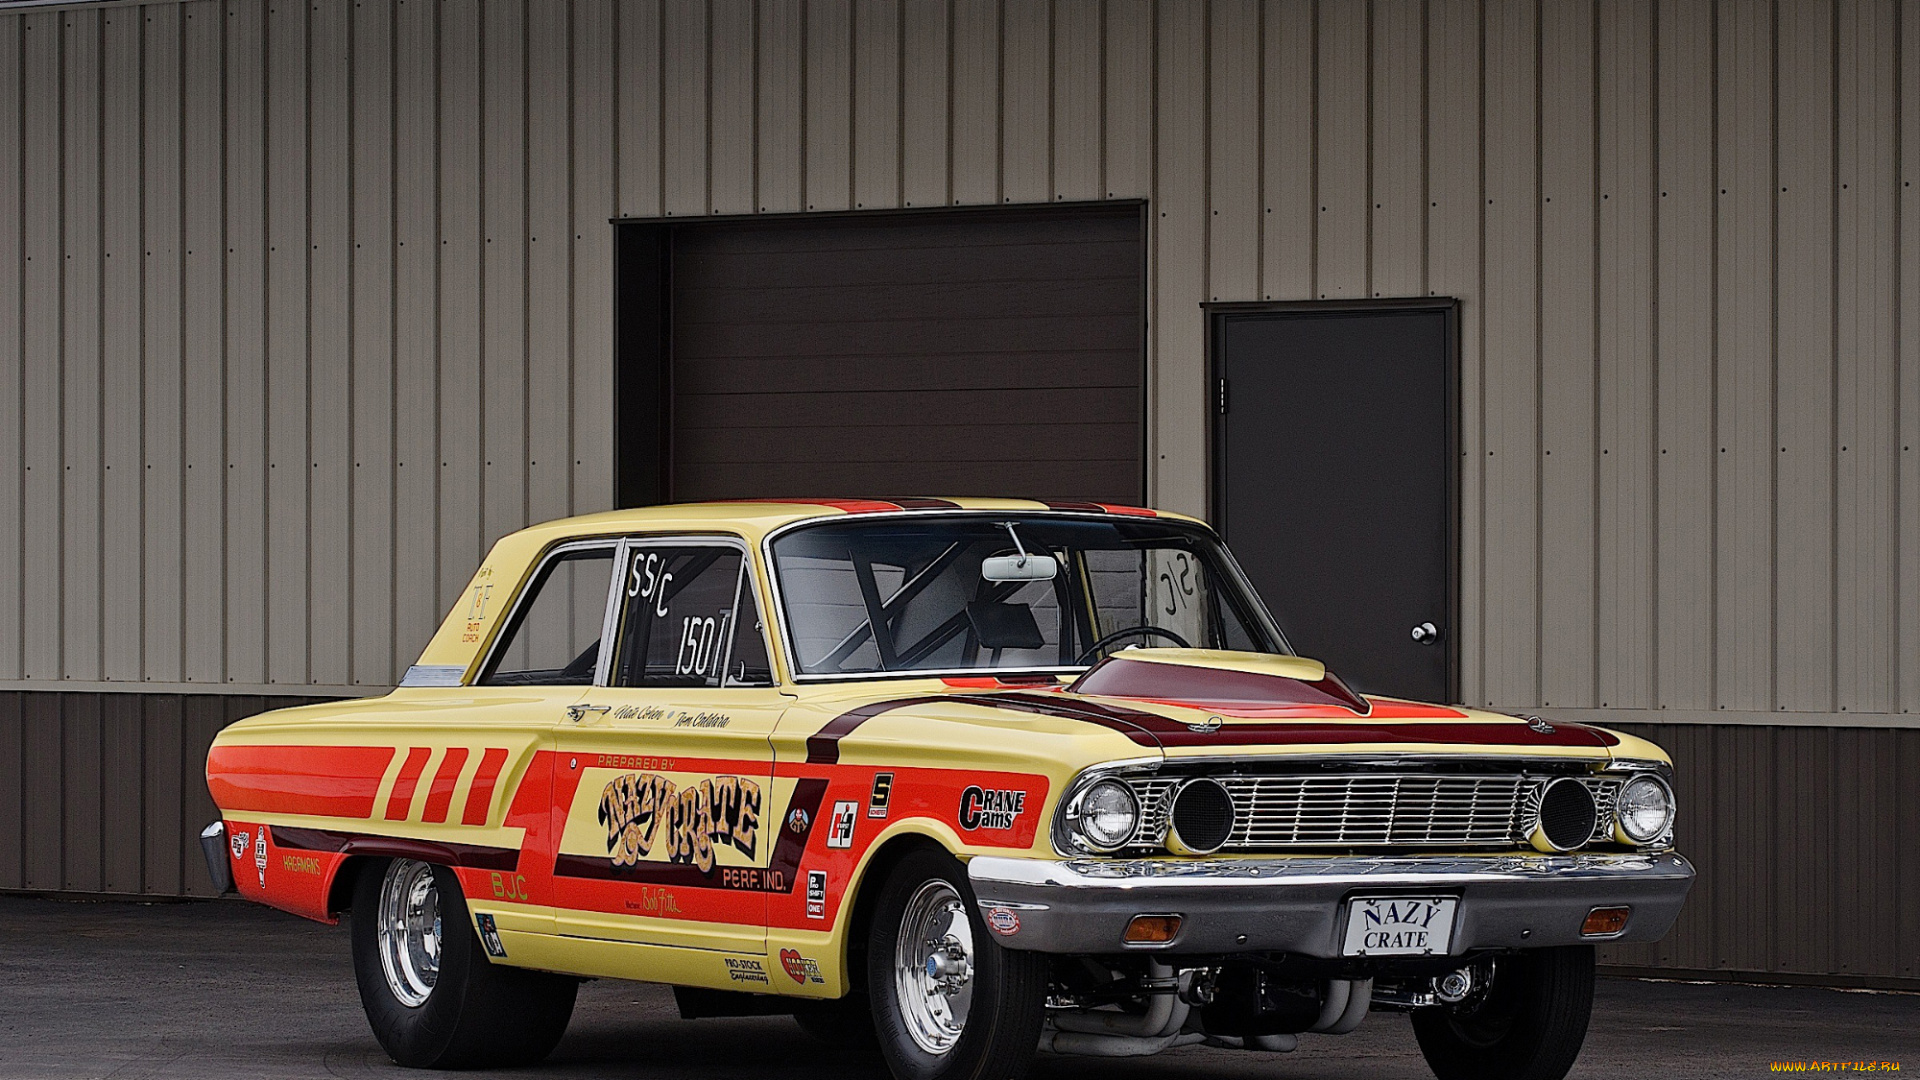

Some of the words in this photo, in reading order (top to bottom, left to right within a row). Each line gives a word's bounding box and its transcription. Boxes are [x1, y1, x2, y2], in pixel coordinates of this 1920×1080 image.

[628, 553, 673, 617] SS/C
[597, 755, 659, 769] PREPARED
[660, 758, 676, 770] BY
[959, 786, 1026, 830] CRANE
[664, 775, 762, 874] CRATE
[491, 872, 529, 900] BJC
[723, 868, 760, 888] PERF.
[763, 871, 787, 891] IND.
[642, 886, 658, 910] Bob
[809, 889, 824, 897] SHIFT
[1363, 901, 1441, 931] NAZY
[1364, 931, 1429, 949] CRATE
[724, 957, 763, 970] PRO-STOCK
